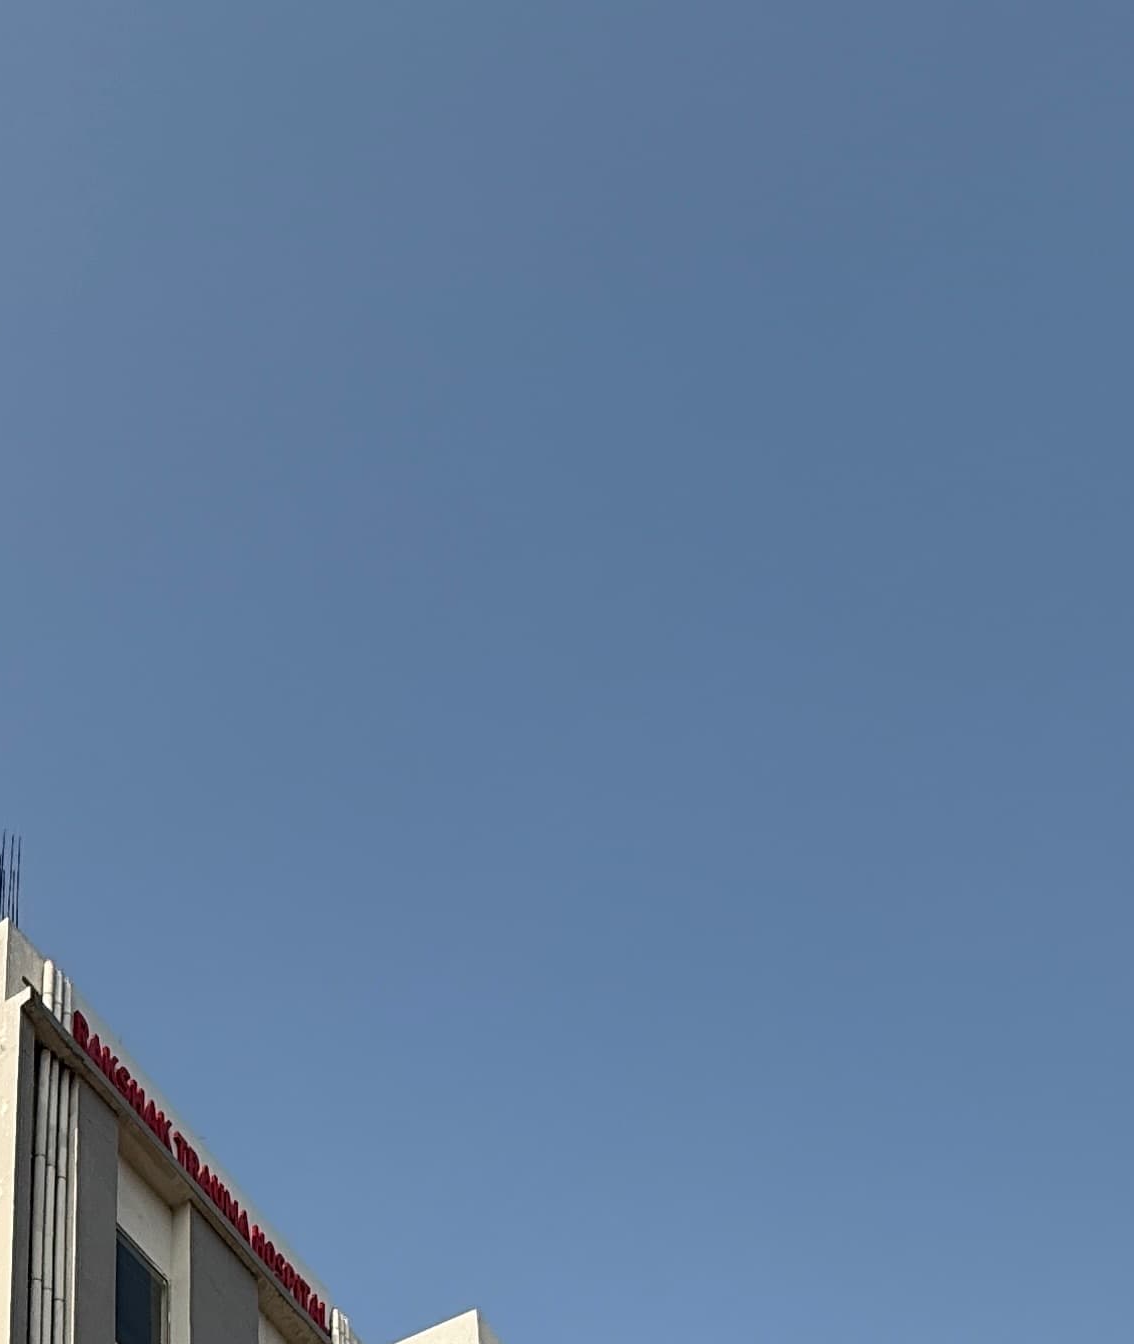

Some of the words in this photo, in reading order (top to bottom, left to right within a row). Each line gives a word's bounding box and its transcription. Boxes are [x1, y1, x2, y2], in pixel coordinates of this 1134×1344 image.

[73, 1010, 173, 1152] RAKSHAK
[174, 1131, 251, 1245] TRAUMA
[251, 1224, 331, 1336] HOSPITAL
